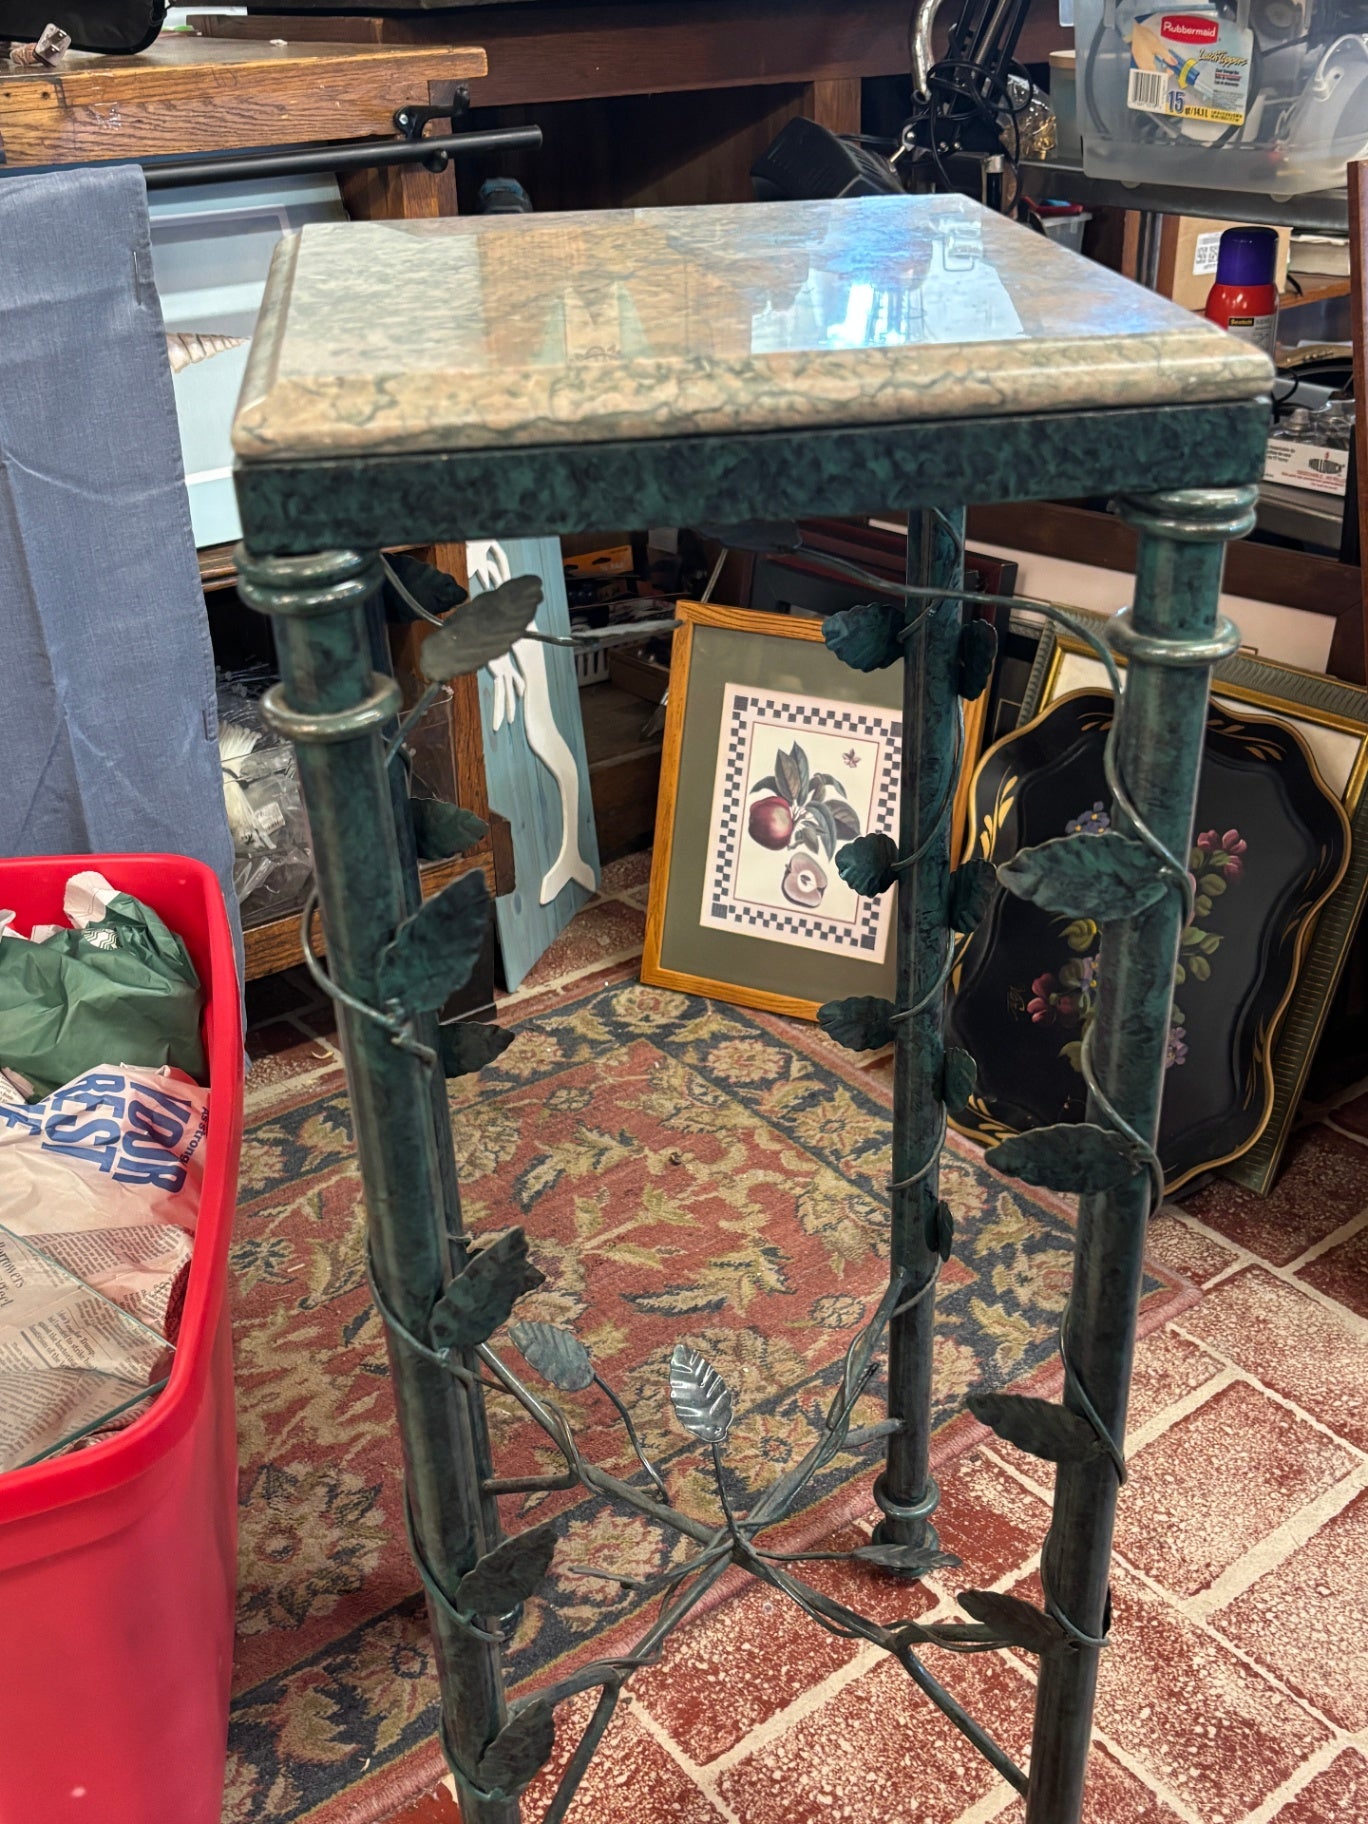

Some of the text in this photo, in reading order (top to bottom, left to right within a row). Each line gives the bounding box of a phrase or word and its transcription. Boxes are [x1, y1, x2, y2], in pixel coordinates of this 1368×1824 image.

[1163, 21, 1216, 37] Rubbermaid
[1168, 90, 1185, 114] 15
[41, 1073, 126, 1173] BEST
[112, 1081, 192, 1193] YOUR
[180, 1122, 207, 1165] strong
